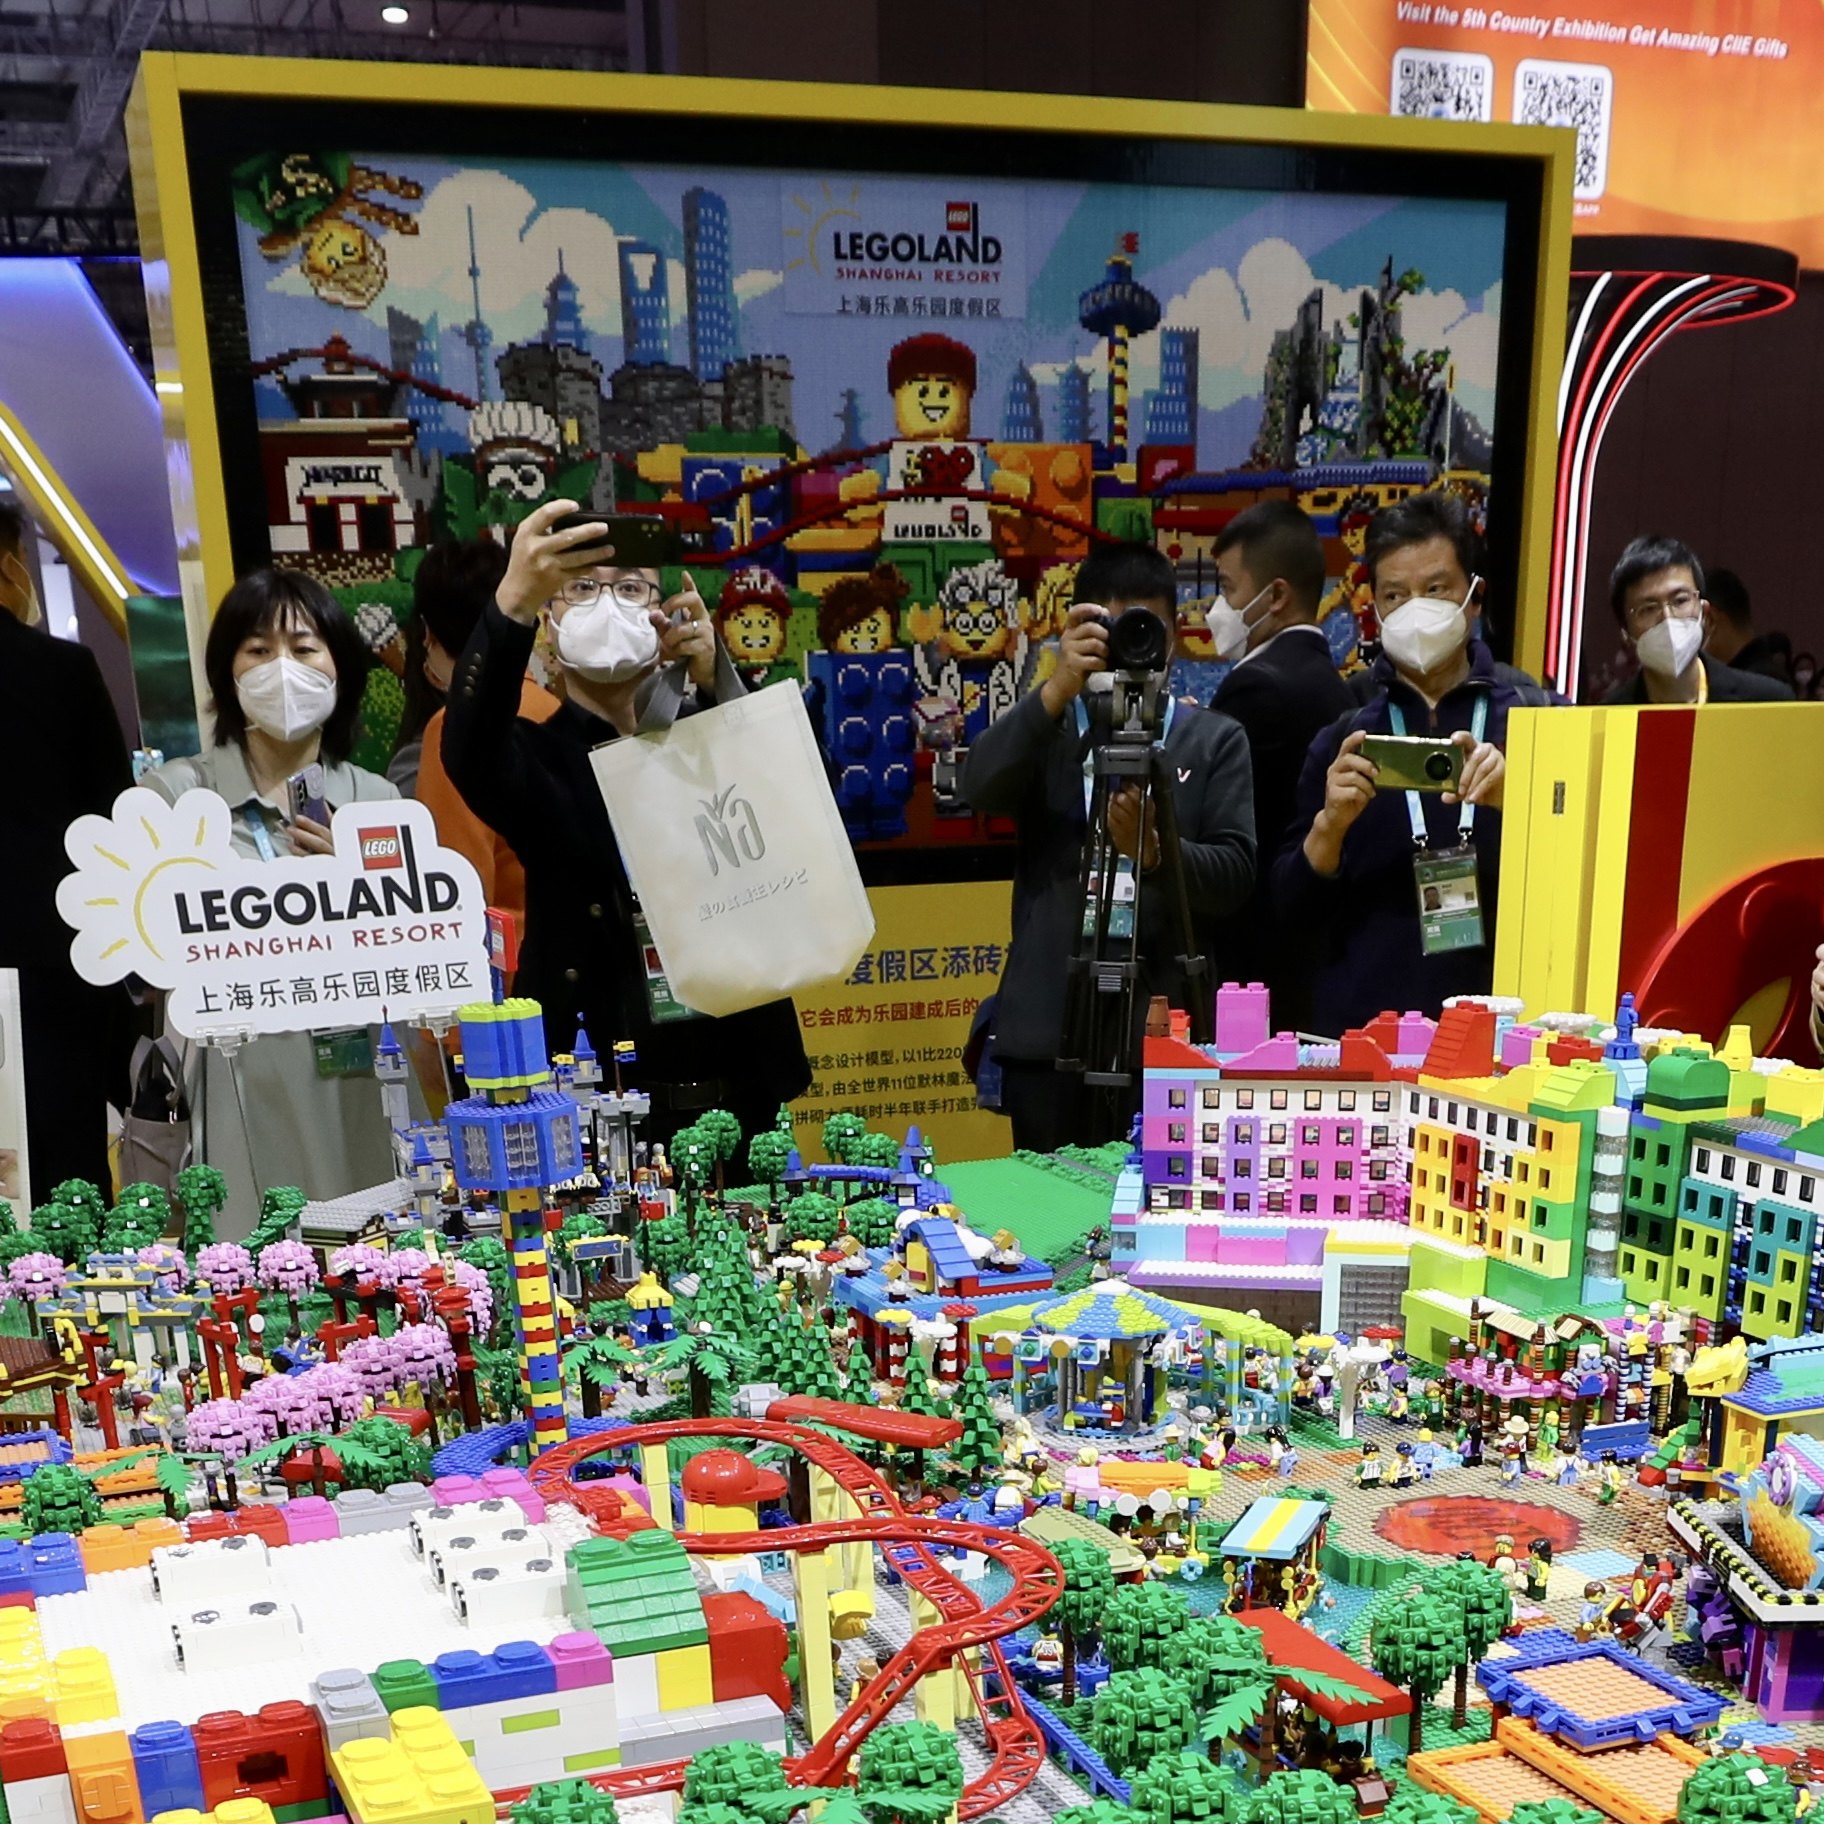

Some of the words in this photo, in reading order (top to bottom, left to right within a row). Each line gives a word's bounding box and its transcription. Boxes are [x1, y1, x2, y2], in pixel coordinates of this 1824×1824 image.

[1397, 1, 1432, 23] Visit
[1434, 5, 1459, 26] the
[1462, 8, 1487, 29] 5th
[1489, 10, 1551, 40] Country
[1552, 17, 1627, 42] Exhibition
[1629, 25, 1657, 45] Get
[1657, 28, 1720, 57] Amazing
[1722, 34, 1752, 57] CIIE
[1753, 38, 1789, 59] Gifts
[833, 202, 1002, 264] LEGOLAND
[836, 266, 922, 282] SHANGHAI
[836, 293, 1002, 318] 上海乐高乐园度假区
[363, 842, 398, 857] LEGO
[174, 824, 460, 934] LEGOLAND
[185, 933, 334, 964] SHANGHAI
[351, 921, 464, 949] RESORT
[844, 943, 1010, 986] 度假区添砖
[194, 960, 474, 1015] 上海乐高乐园度假区
